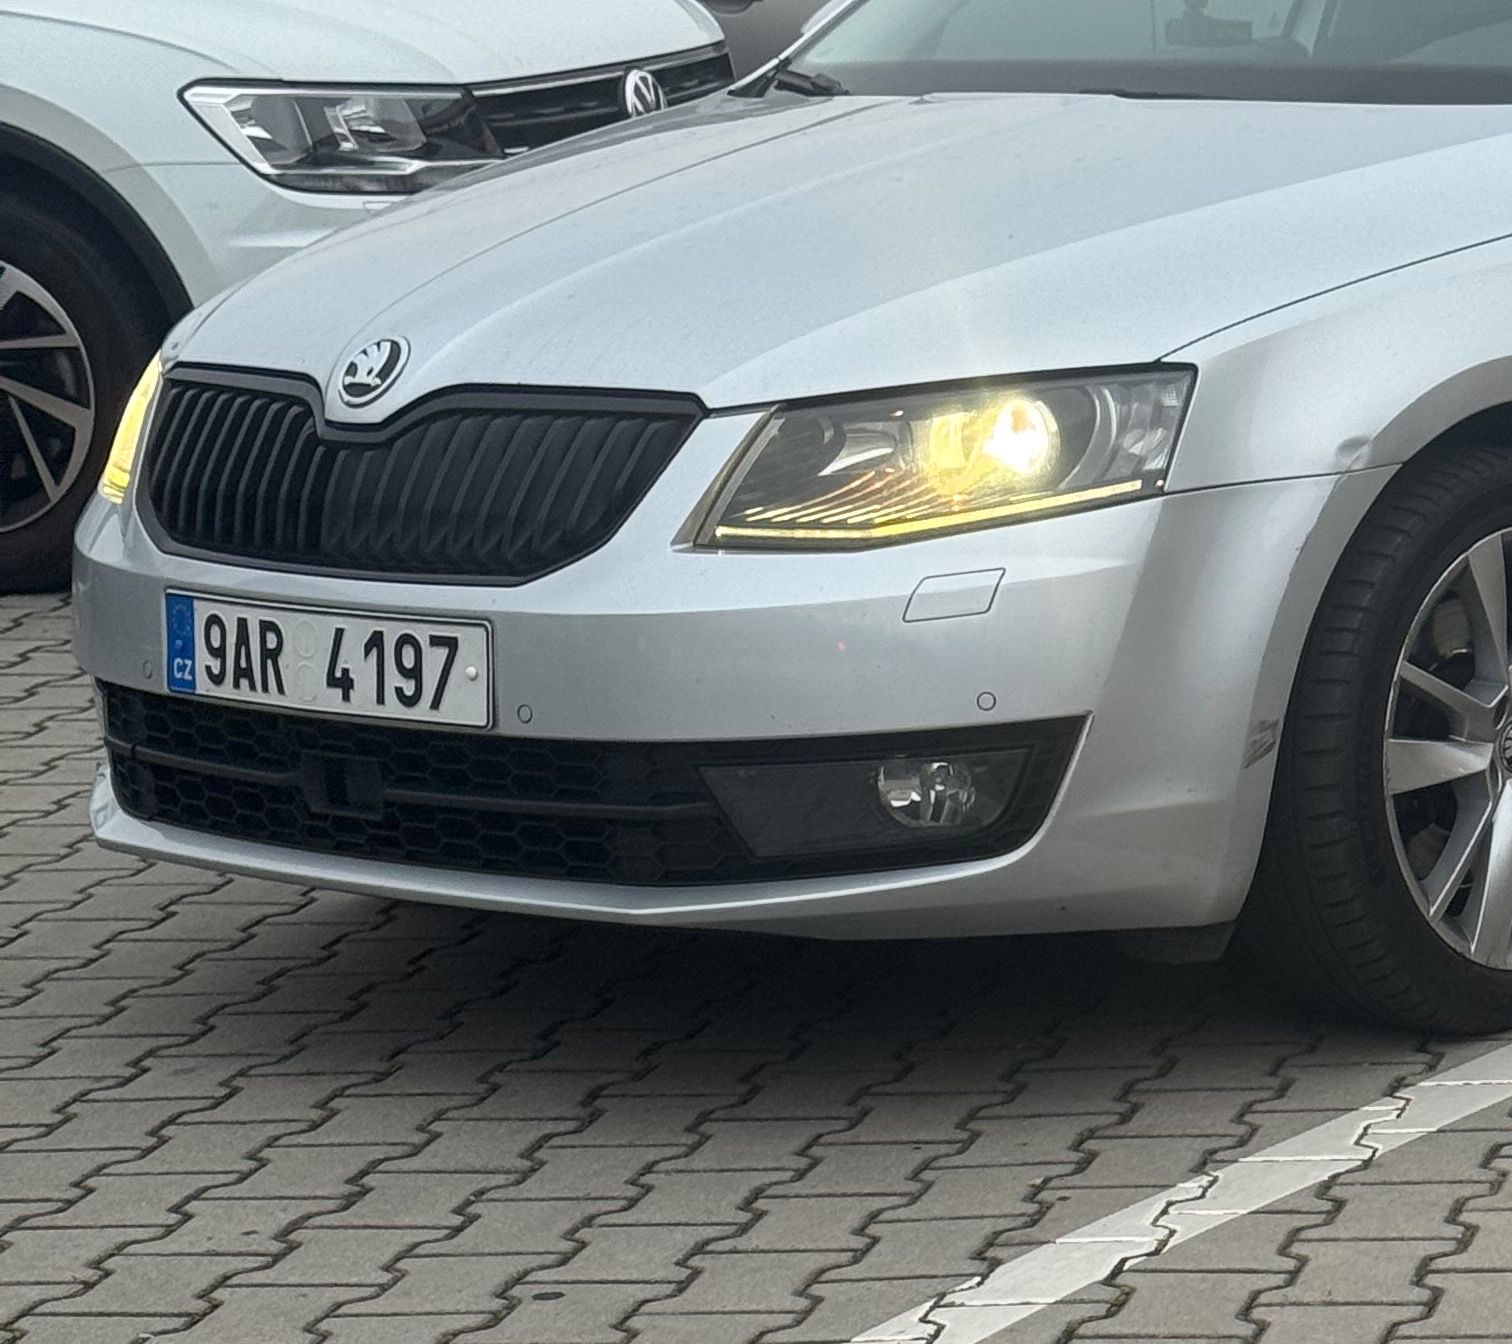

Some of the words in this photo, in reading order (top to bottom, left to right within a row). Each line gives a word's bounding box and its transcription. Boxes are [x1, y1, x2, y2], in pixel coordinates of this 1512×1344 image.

[173, 657, 193, 681] CZ
[203, 613, 287, 697] 9AR
[326, 626, 459, 711] 4197
